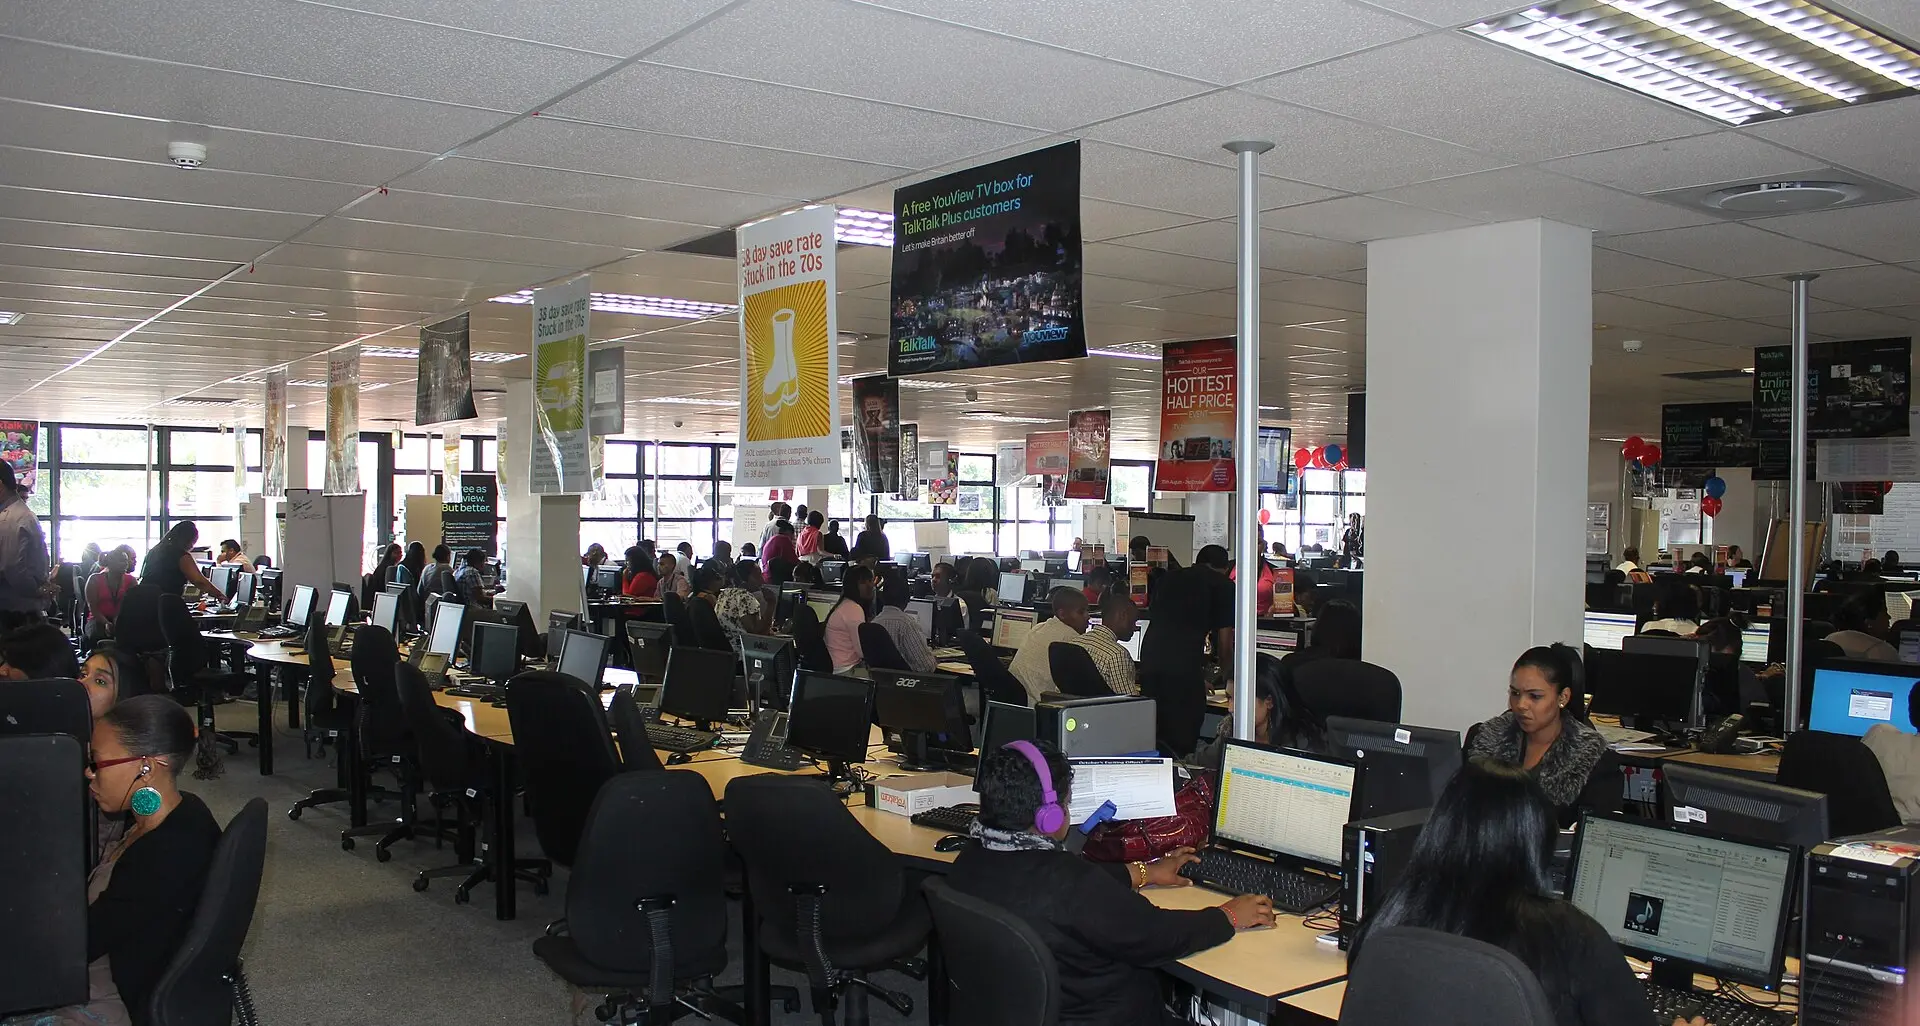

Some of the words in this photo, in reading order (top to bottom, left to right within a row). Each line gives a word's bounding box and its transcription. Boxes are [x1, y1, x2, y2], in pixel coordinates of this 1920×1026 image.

[902, 204, 910, 217] A
[911, 199, 931, 214] free
[932, 189, 974, 210] YouView
[976, 182, 993, 198] TV
[994, 178, 1014, 194] box
[1016, 173, 1033, 188] for
[902, 216, 939, 236] TalkTalk
[942, 212, 962, 227] Plus
[964, 197, 1021, 221] customers
[753, 245, 767, 263] day
[770, 240, 793, 258] save
[796, 232, 822, 252] rate
[902, 242, 915, 253] Let's
[916, 239, 931, 250] make
[931, 234, 948, 246] Britain
[949, 231, 966, 242] better
[966, 227, 976, 237] off
[767, 262, 775, 280] in
[779, 258, 796, 278] the
[800, 253, 822, 273] 70s
[898, 336, 937, 352] TalkTalk
[1193, 366, 1207, 375] OUR
[1167, 375, 1234, 394] HOTTEST
[1167, 395, 1197, 409] HALF
[1200, 393, 1233, 408] PRICE
[1760, 390, 1780, 402] TV
[1189, 410, 1209, 419] EVENT
[802, 457, 812, 465] 5%
[814, 456, 832, 464] churn
[460, 504, 490, 512] better.
[896, 678, 920, 687] acer
